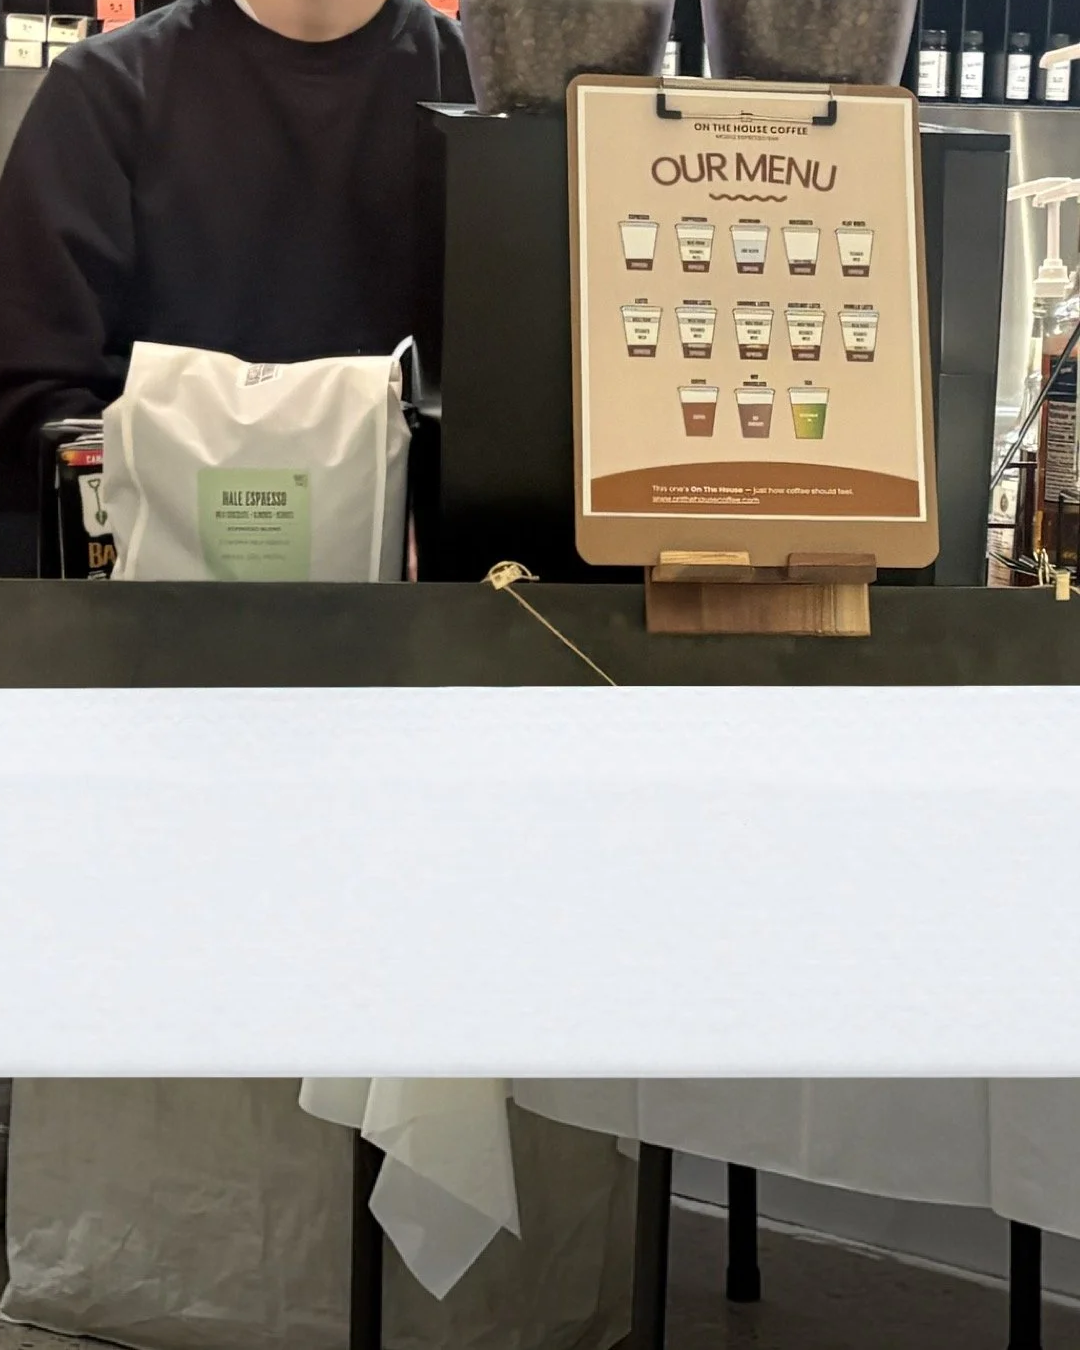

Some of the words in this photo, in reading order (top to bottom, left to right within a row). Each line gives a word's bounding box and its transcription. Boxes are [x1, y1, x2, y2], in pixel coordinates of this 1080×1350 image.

[694, 123, 710, 131] ON
[713, 123, 731, 132] THE
[733, 124, 768, 134] HOUSE
[770, 126, 808, 135] COFFEE
[651, 152, 728, 186] OUR
[735, 153, 837, 192] MENU
[246, 491, 287, 506] ESPRESSO
